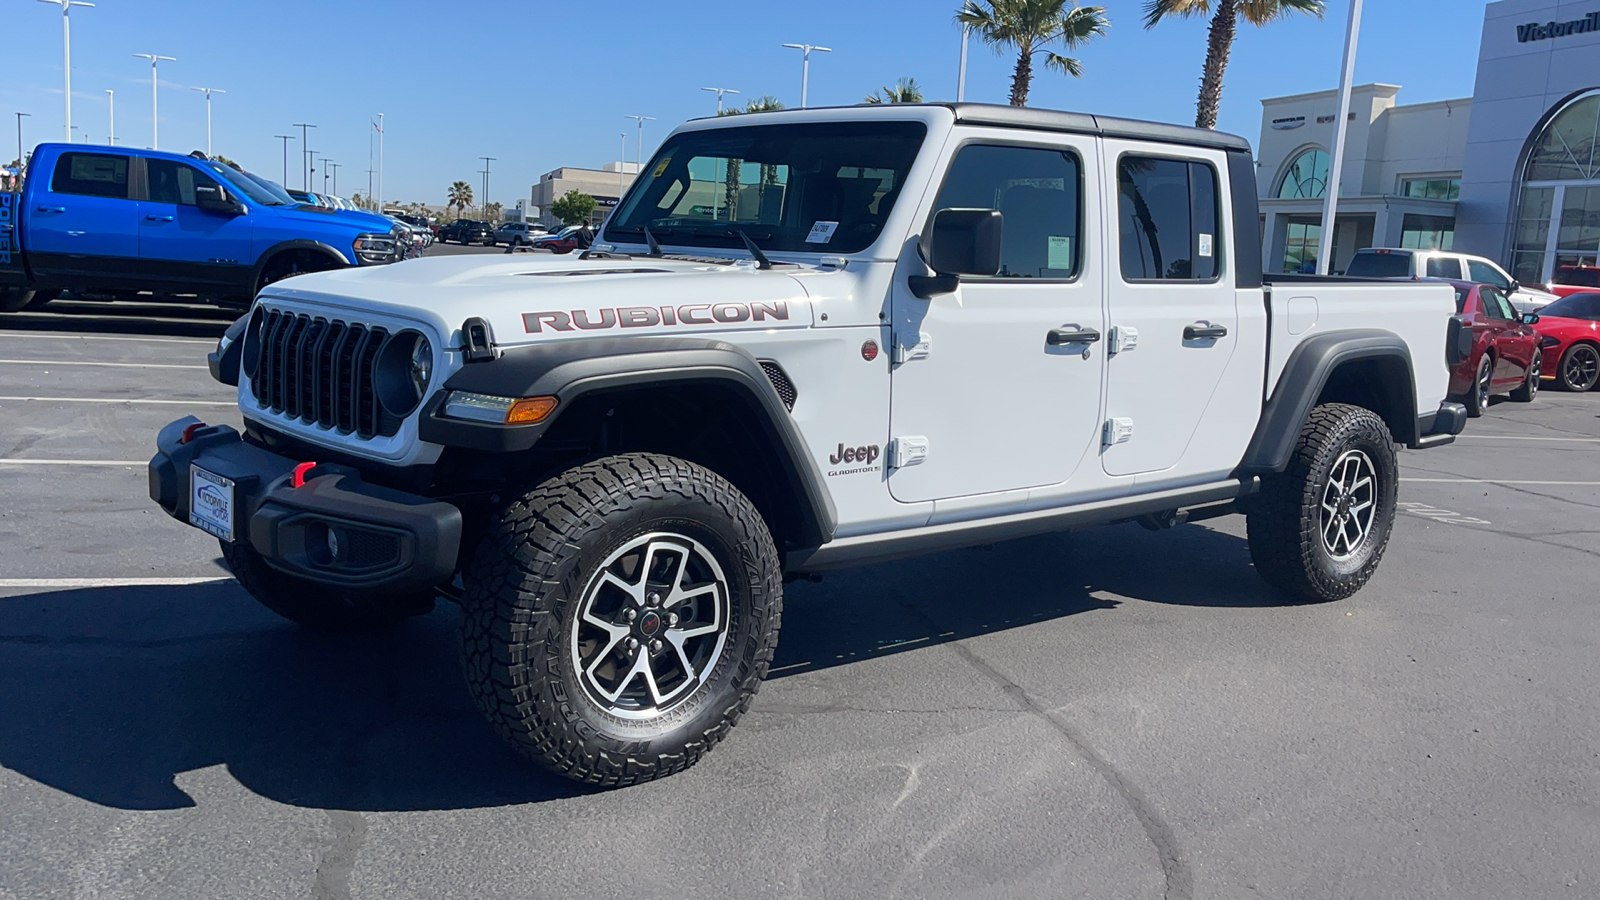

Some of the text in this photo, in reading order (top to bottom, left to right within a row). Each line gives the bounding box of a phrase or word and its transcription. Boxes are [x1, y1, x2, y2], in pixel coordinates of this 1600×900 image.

[0, 193, 11, 264] POWER
[521, 301, 789, 334] RUBICON
[829, 442, 880, 465] Jeep
[828, 467, 874, 477] GLADIATOR
[201, 490, 228, 509] VICTORVILLE
[212, 507, 229, 523] MOTORS
